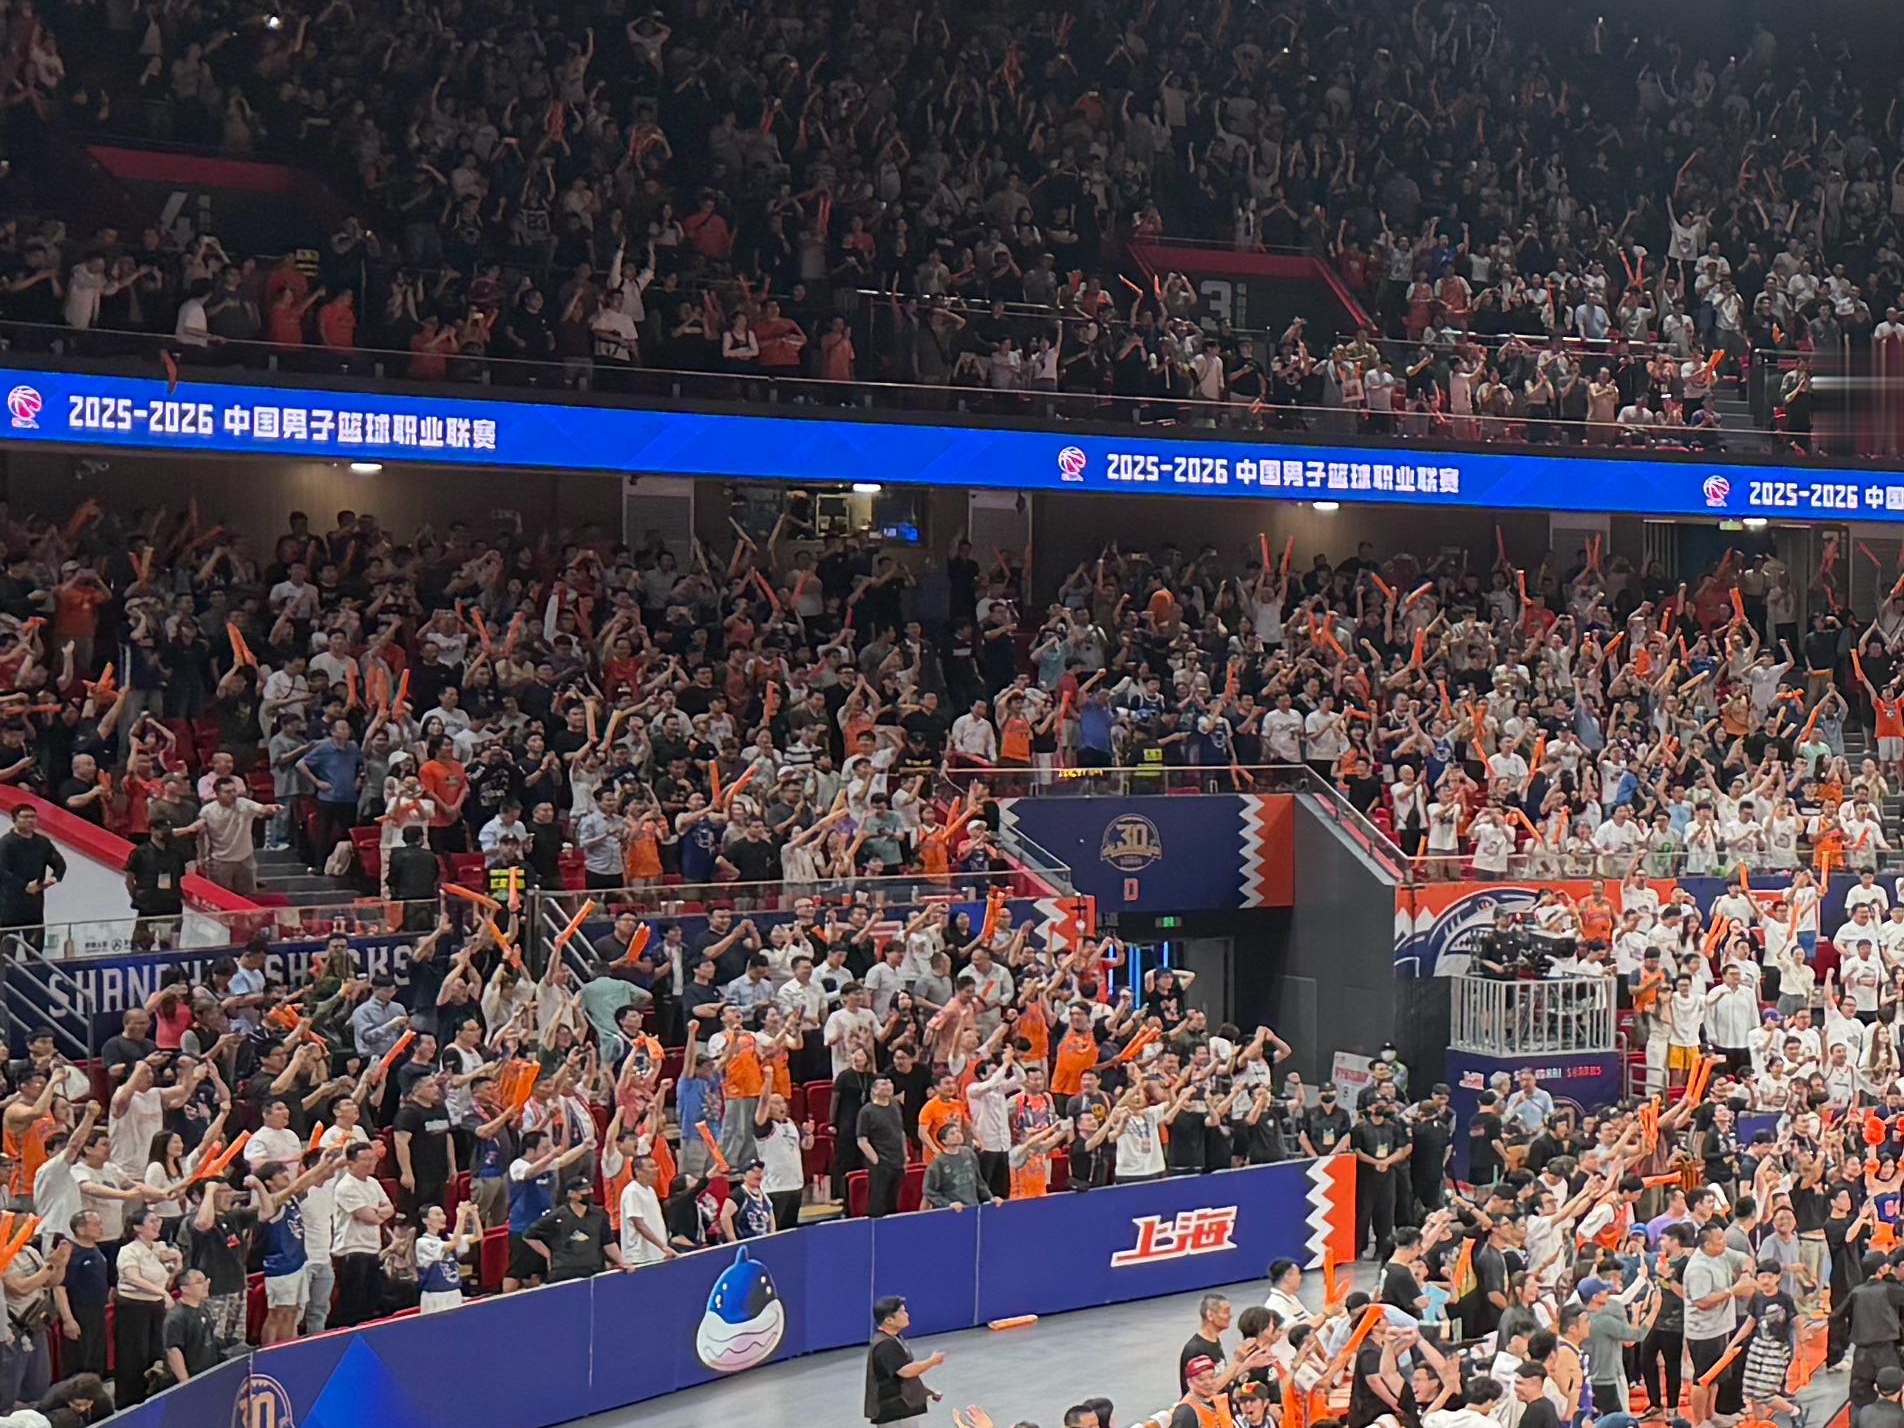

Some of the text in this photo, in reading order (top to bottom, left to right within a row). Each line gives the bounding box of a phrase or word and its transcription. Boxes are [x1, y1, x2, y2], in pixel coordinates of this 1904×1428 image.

[69, 395, 497, 450] 2025-2026 中国男子篮球职业联赛
[1107, 453, 1460, 494] 2025-2026 中国男子篮球职业联赛
[1749, 481, 1858, 509] 2025-2026
[1123, 878, 1140, 901] D
